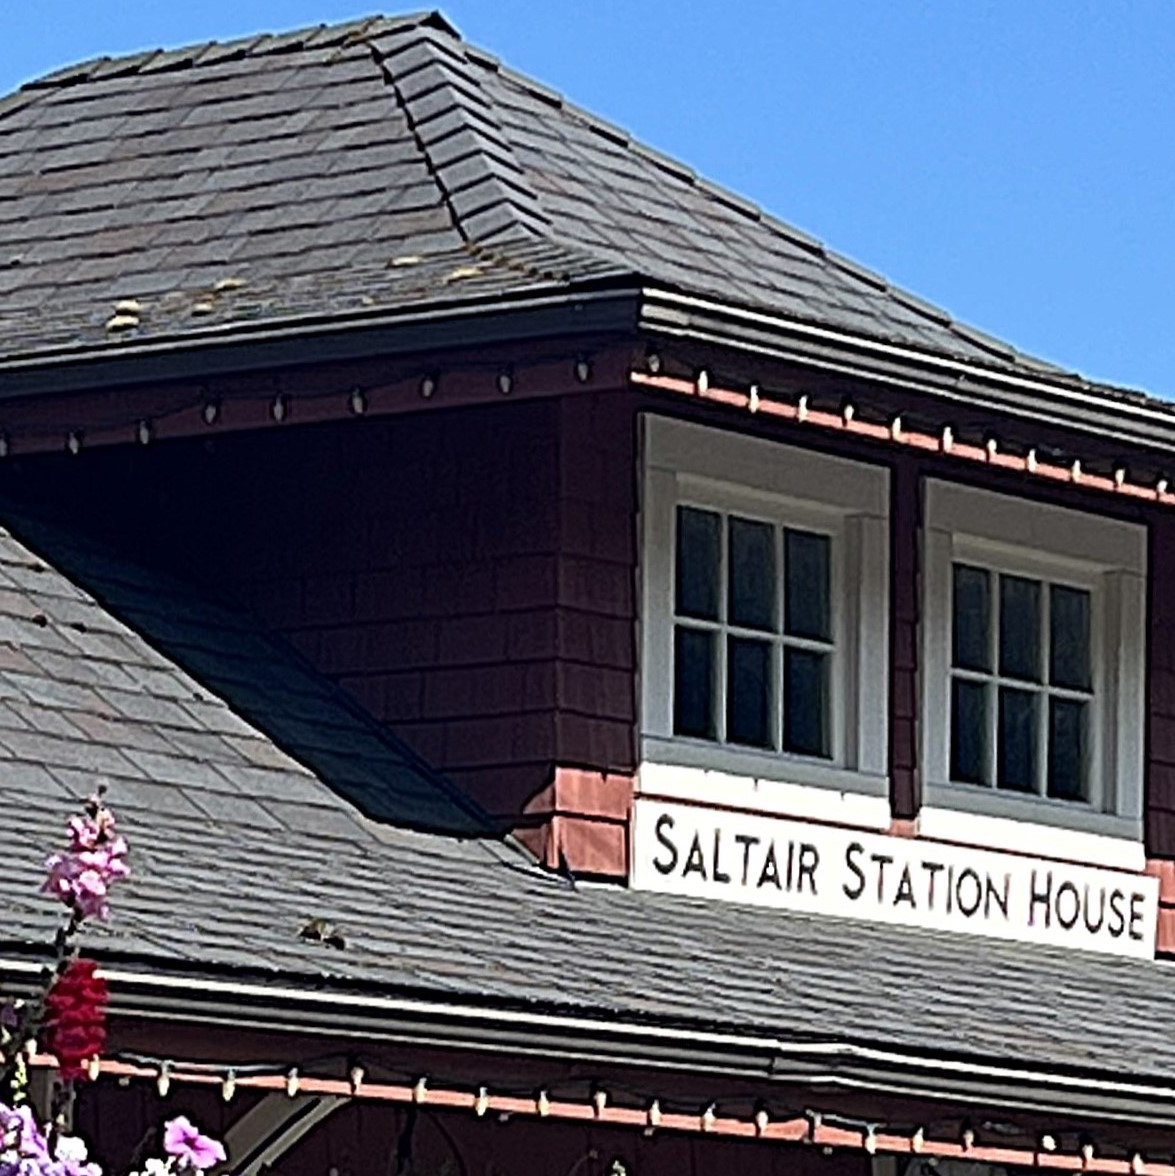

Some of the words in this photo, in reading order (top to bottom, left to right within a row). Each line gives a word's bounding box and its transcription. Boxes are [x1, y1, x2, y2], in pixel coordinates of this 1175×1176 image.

[653, 813, 820, 896] SALTAIR
[842, 842, 1011, 921] STATION
[1027, 870, 1145, 942] HOUSE
